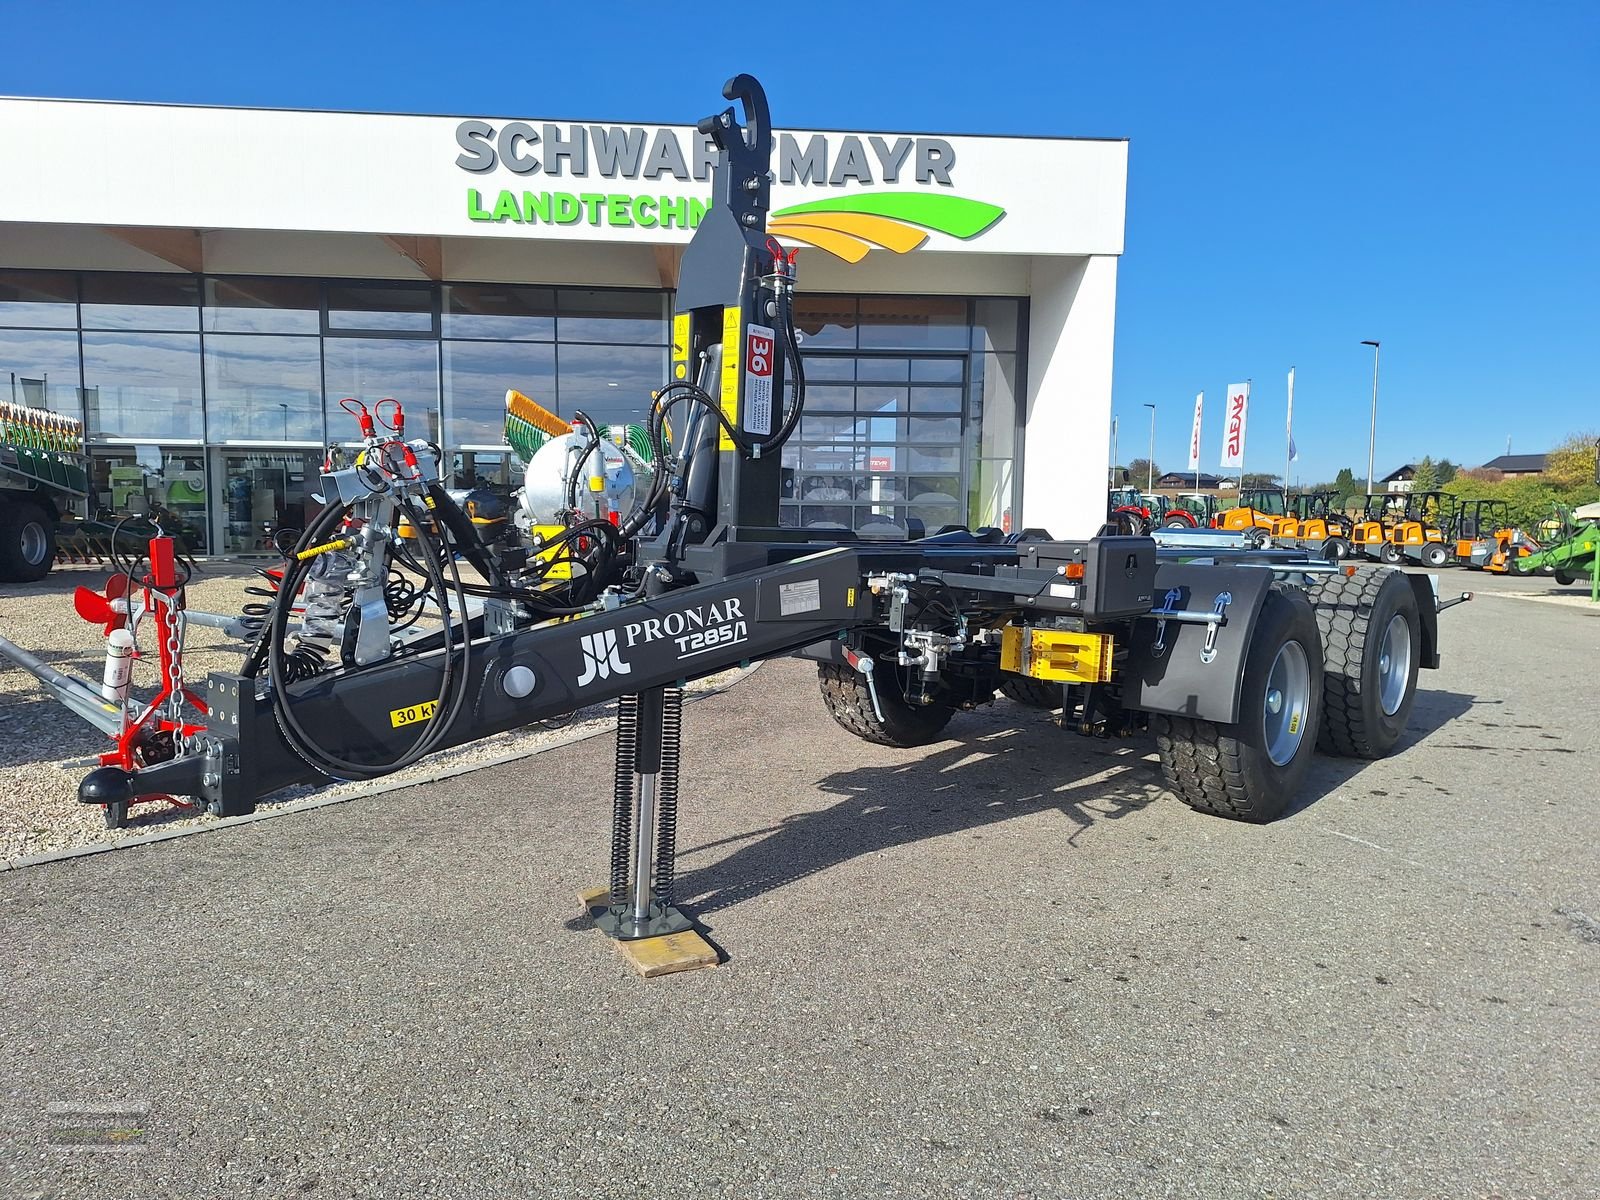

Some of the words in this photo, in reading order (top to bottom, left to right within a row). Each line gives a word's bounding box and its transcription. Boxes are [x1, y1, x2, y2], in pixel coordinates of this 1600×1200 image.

[455, 120, 956, 187] SCHWARMAYR
[751, 338, 769, 372] 36
[624, 597, 745, 648] PRONAR
[674, 620, 748, 653] T285/1
[397, 708, 416, 723] 30
